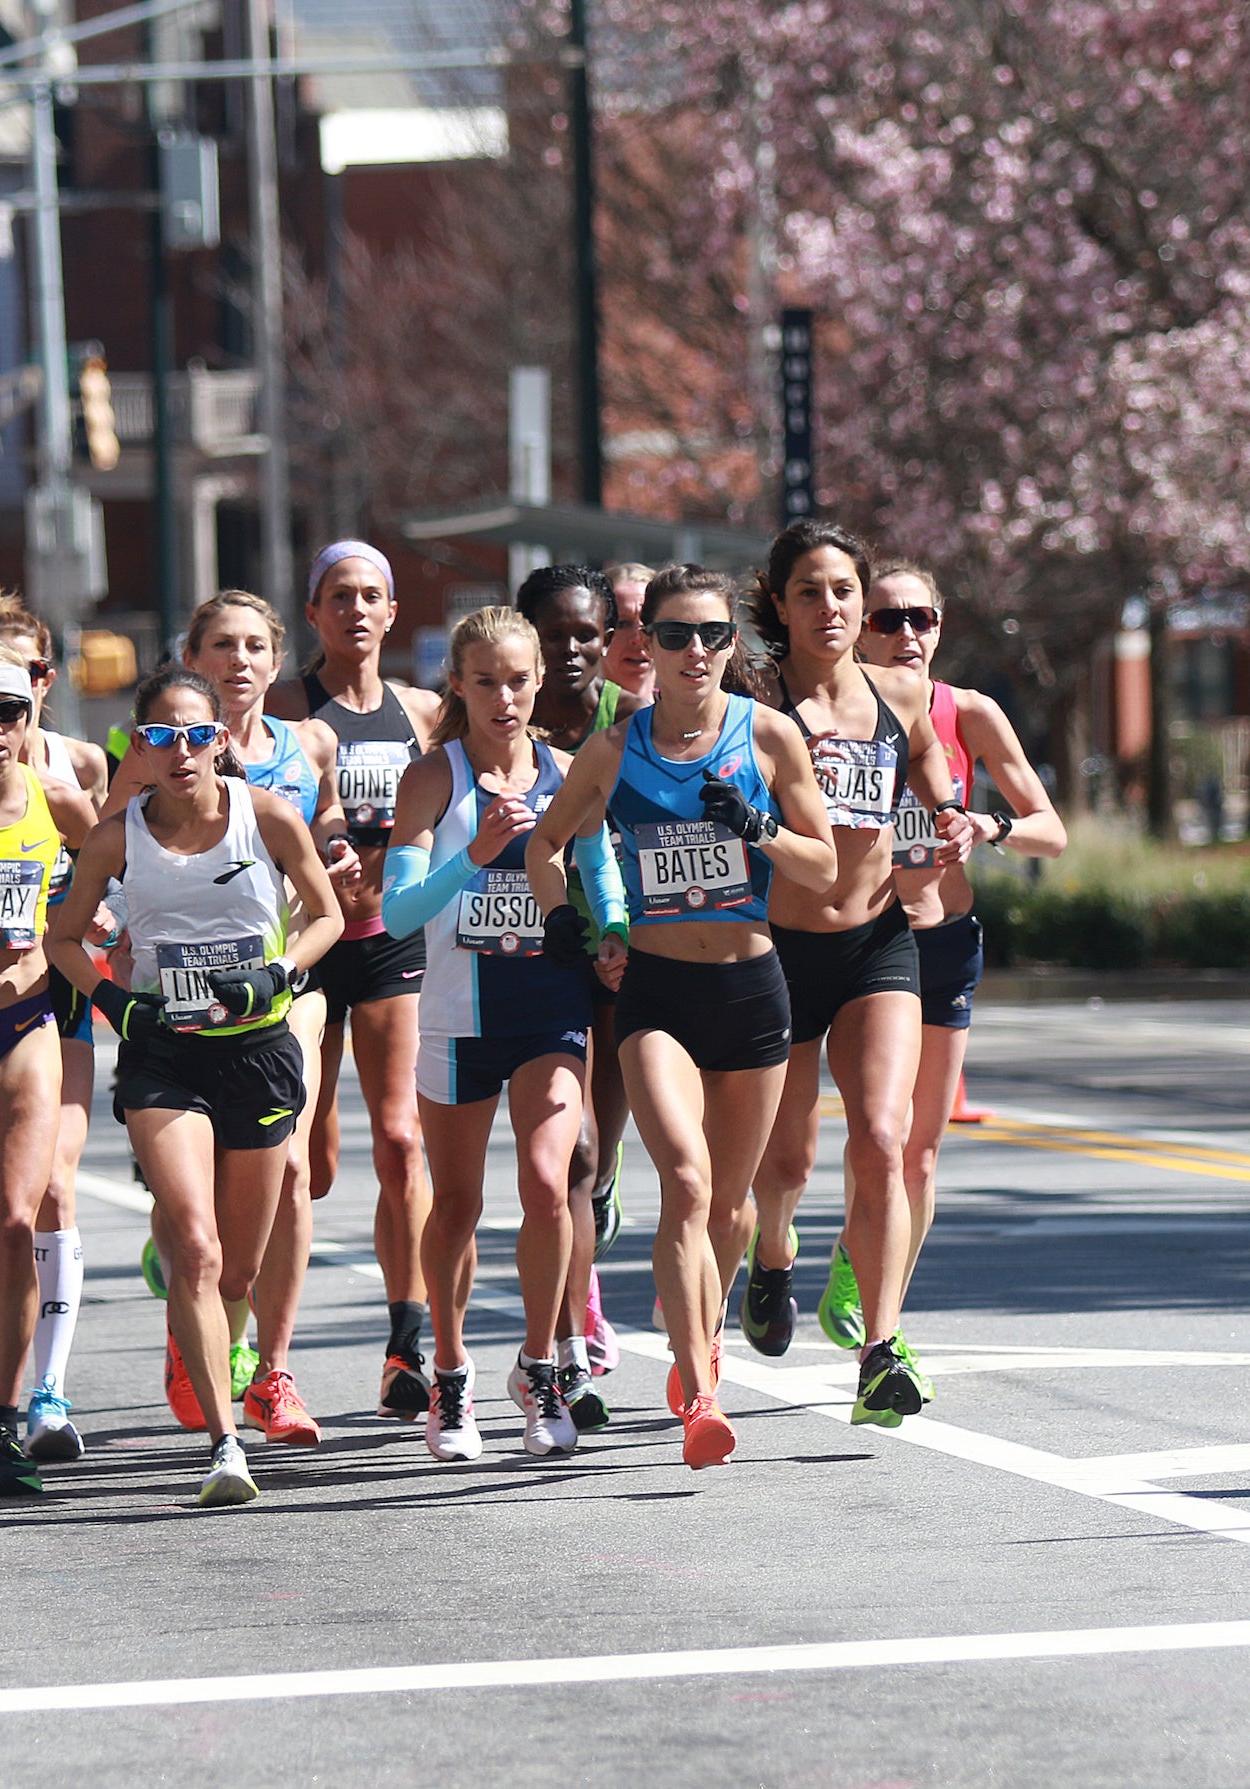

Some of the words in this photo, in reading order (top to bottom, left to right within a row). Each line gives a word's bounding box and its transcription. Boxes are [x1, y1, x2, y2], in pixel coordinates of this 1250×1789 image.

[820, 766, 883, 802] OJAS
[657, 826, 674, 836] U.S.
[676, 821, 714, 835] OLYMPIC
[659, 835, 684, 847] TEAM
[686, 833, 716, 845] TRIALS
[654, 844, 729, 884] BATES
[487, 873, 503, 883] U.S.
[488, 883, 510, 893] TEAM
[511, 883, 533, 893] TRIA
[181, 946, 198, 957] U.S.
[199, 943, 238, 956] OLYMPIC
[182, 957, 207, 967] TEAM
[209, 953, 239, 965] TRIALS
[172, 962, 252, 1001] LIN
